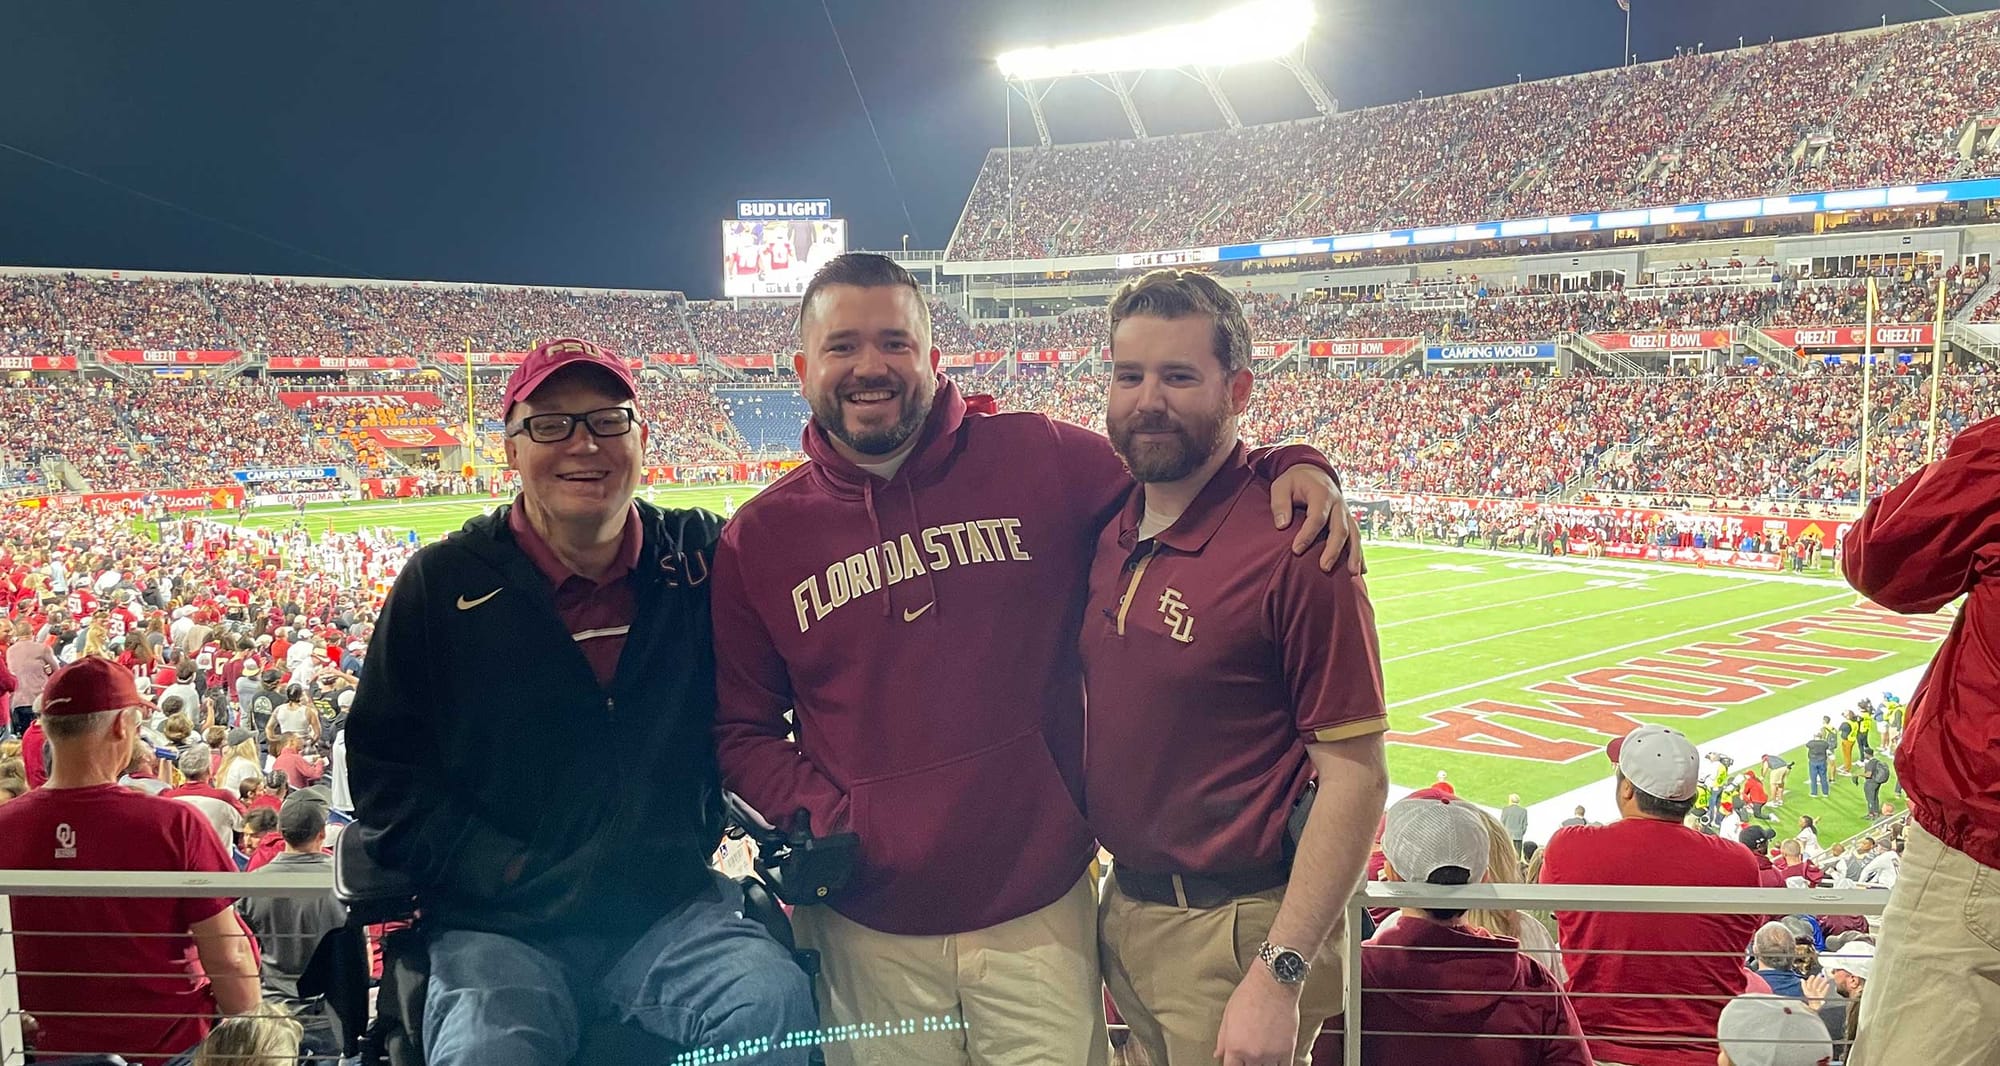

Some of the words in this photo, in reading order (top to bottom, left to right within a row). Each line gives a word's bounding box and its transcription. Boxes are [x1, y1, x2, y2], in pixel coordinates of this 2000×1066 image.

[740, 202, 776, 217] BUD
[777, 202, 827, 216] LIGHT
[1670, 333, 1702, 347] BOWL
[1361, 342, 1384, 354] BOWL
[1441, 346, 1493, 359] CAMPING
[1494, 345, 1538, 357] WORLD
[347, 357, 369, 368] BOWL
[246, 471, 291, 481] CAMPING
[291, 469, 325, 479] WORLD
[791, 533, 927, 633] FLORIDA
[921, 517, 1031, 572] STATE
[1156, 585, 1195, 644] FSU
[55, 822, 77, 849] OU
